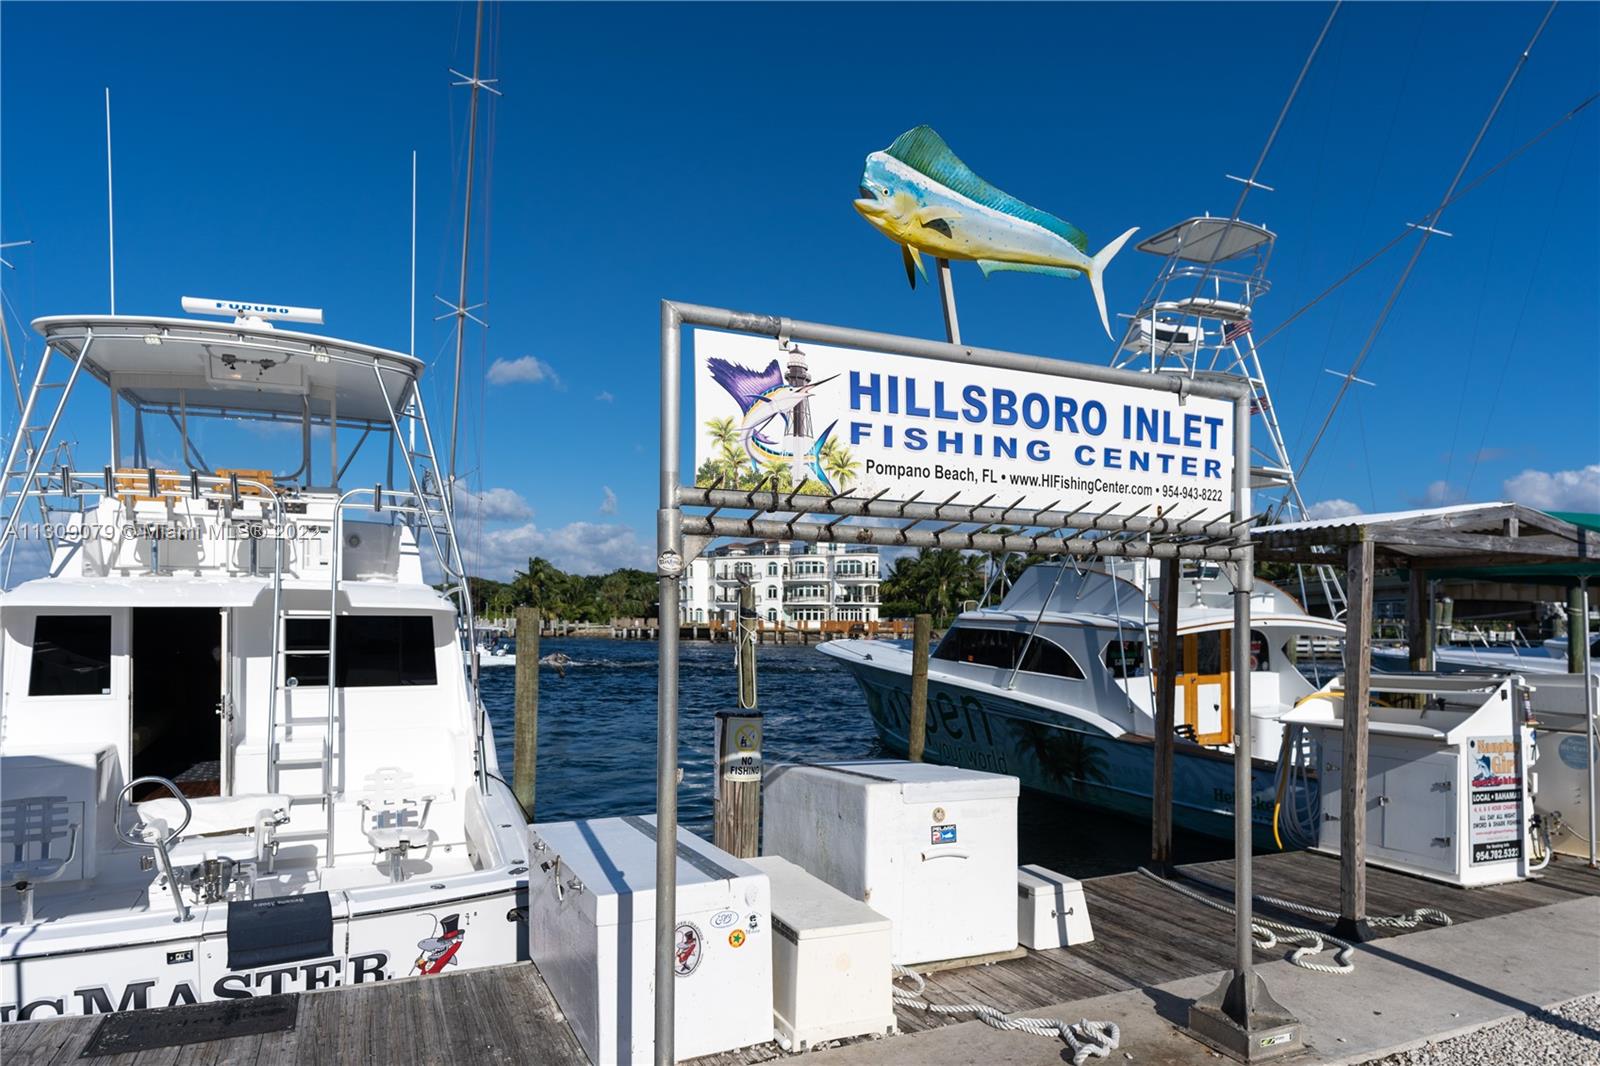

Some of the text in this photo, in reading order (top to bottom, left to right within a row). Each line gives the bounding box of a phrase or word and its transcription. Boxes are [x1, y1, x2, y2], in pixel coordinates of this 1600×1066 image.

[216, 303, 288, 313] FURUNO
[849, 370, 1223, 450] HILLSBORO INLET
[850, 421, 1222, 479] FISHING CENTER
[866, 459, 1223, 502] Pompano Beach, FL www.HIFishingCenter.com 954-943-8222
[741, 756, 753, 766] NO
[968, 750, 1008, 774] world
[730, 765, 760, 776] FISHING
[1472, 793, 1491, 802] LOCAL
